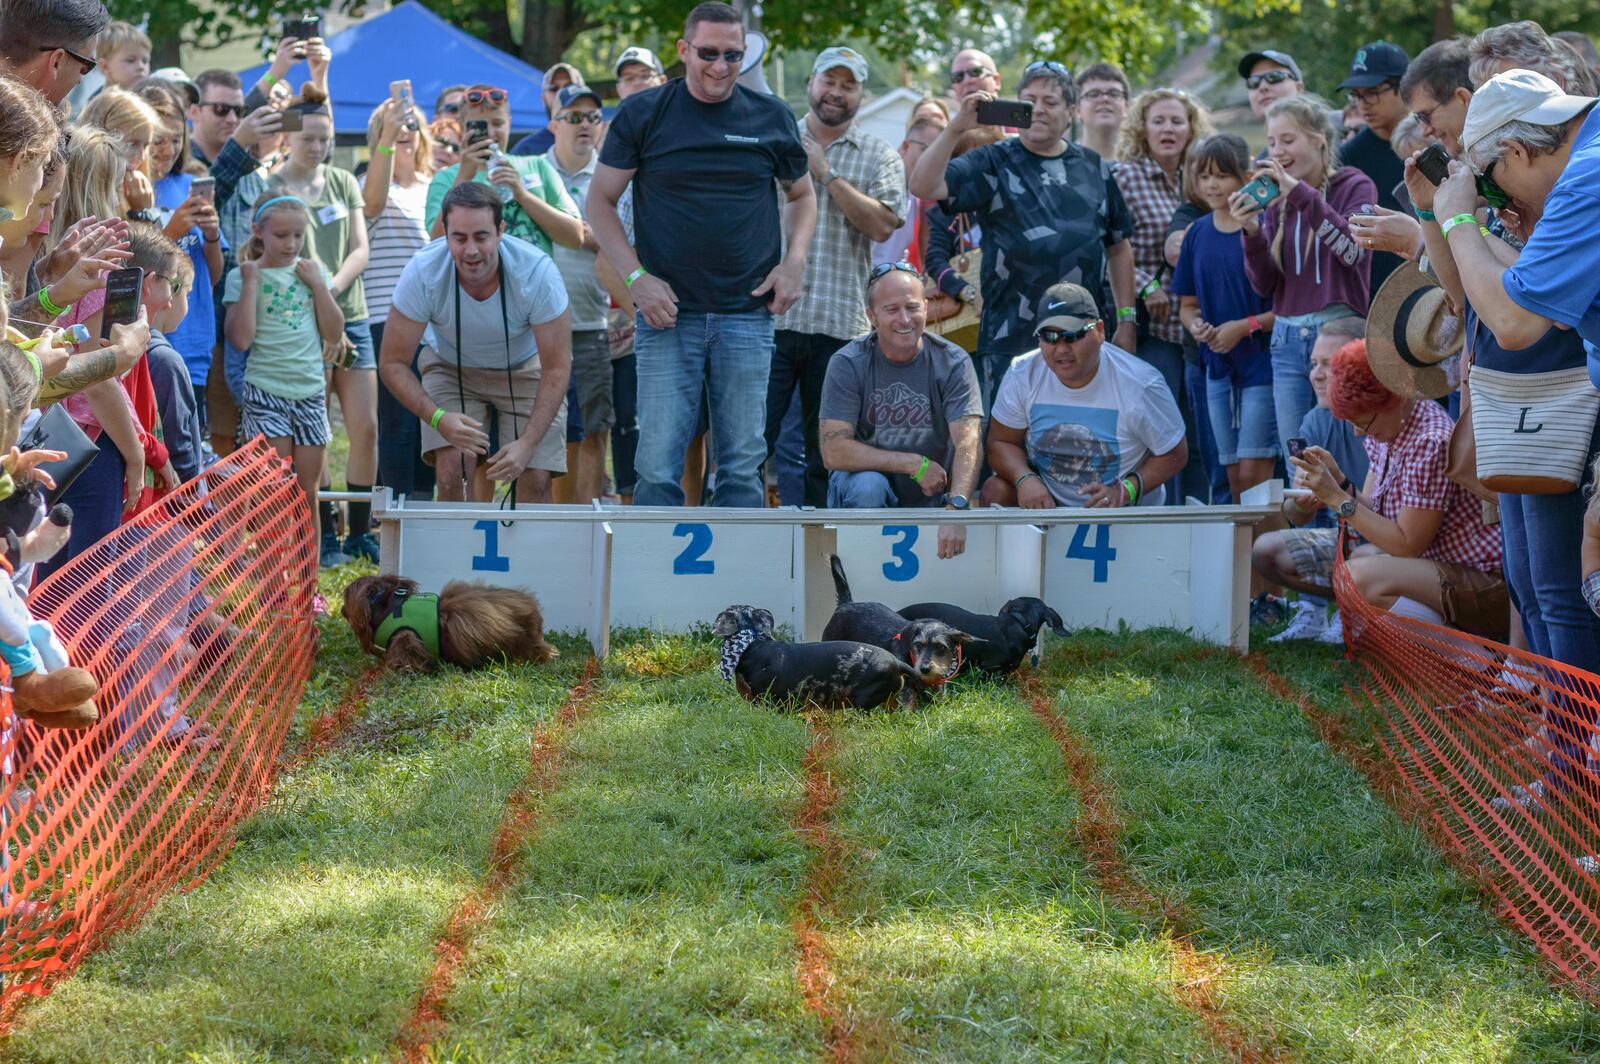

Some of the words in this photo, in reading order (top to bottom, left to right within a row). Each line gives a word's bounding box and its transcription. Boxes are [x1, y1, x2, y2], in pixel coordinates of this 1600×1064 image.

[1513, 406, 1544, 434] L
[472, 520, 510, 573] 1
[672, 522, 715, 576] 2
[881, 524, 920, 582] 3
[1065, 523, 1118, 583] 4
